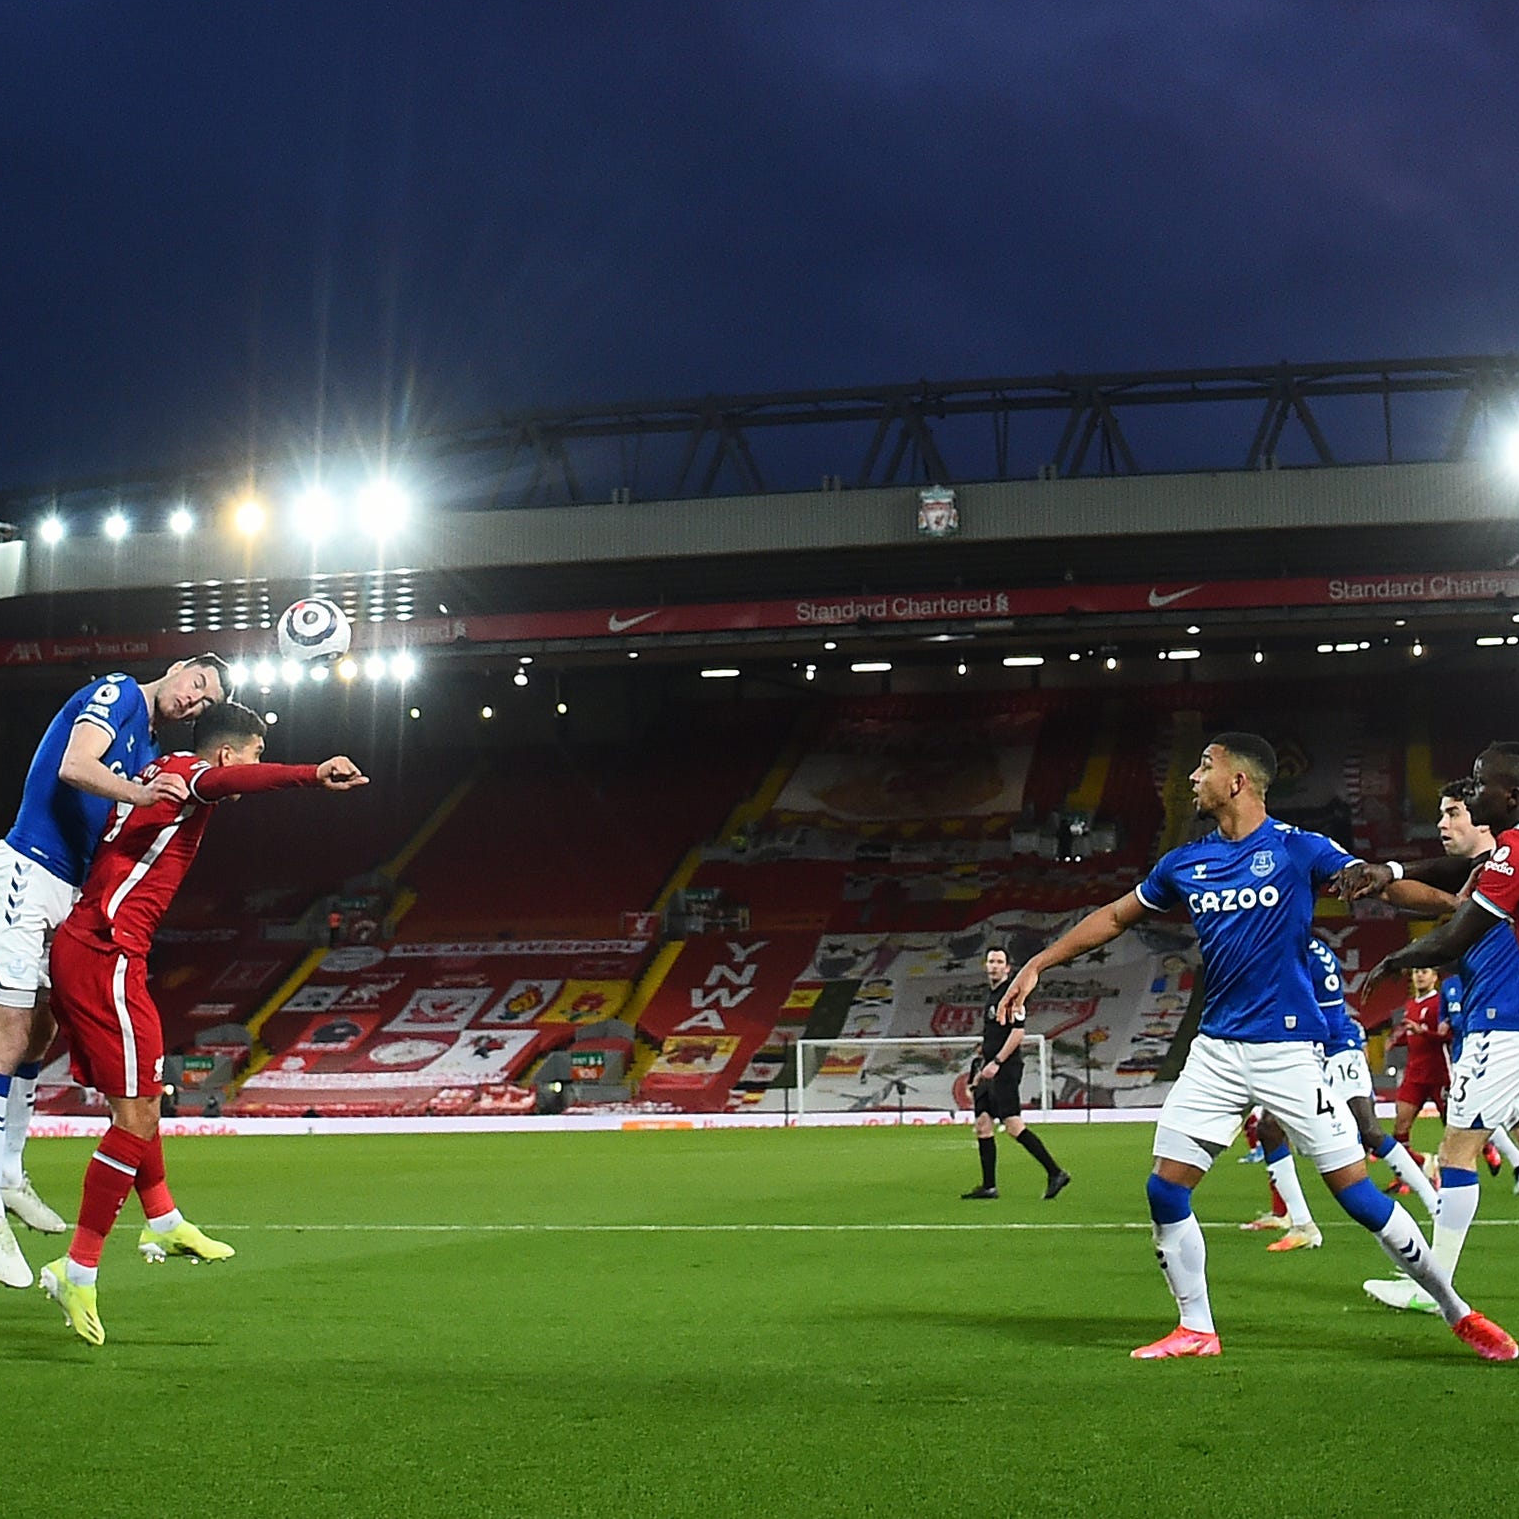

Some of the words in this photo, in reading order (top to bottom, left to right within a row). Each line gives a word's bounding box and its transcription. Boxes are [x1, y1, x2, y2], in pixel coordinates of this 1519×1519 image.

[1328, 578, 1425, 601] Standard
[796, 598, 888, 622] Standard
[892, 594, 992, 617] Chartered
[5, 642, 42, 663] AXA
[53, 644, 91, 657] Know
[95, 642, 121, 654] You
[123, 641, 150, 654] Can
[1482, 859, 1516, 878] pedia
[1188, 884, 1280, 915] CAZOO
[401, 944, 429, 955] WE
[439, 943, 472, 954] ARE
[502, 941, 639, 954] LIVERPOOL
[1338, 1062, 1359, 1082] 16
[1316, 1087, 1336, 1116] 4
